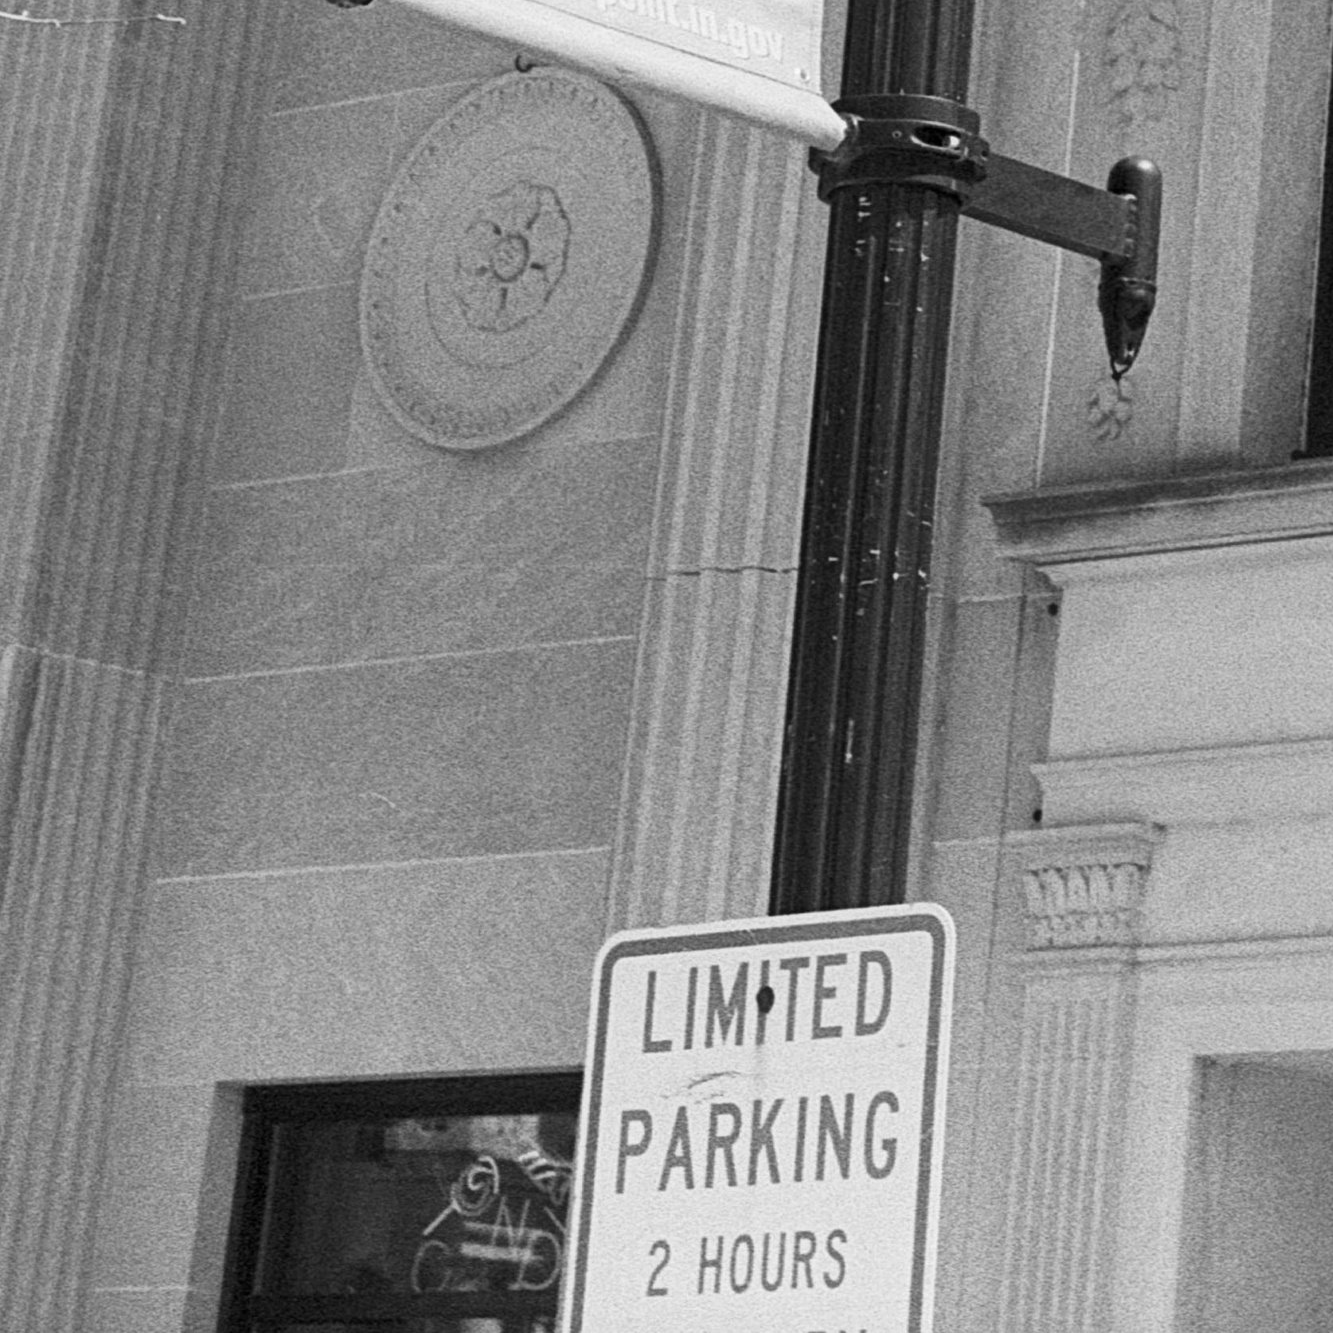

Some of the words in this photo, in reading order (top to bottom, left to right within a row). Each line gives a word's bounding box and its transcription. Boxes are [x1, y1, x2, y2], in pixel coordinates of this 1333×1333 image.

[641, 948, 894, 1054] LIMITED
[615, 1090, 901, 1195] PARKING
[645, 1239, 672, 1298] 2
[697, 1229, 848, 1297] HOURS
